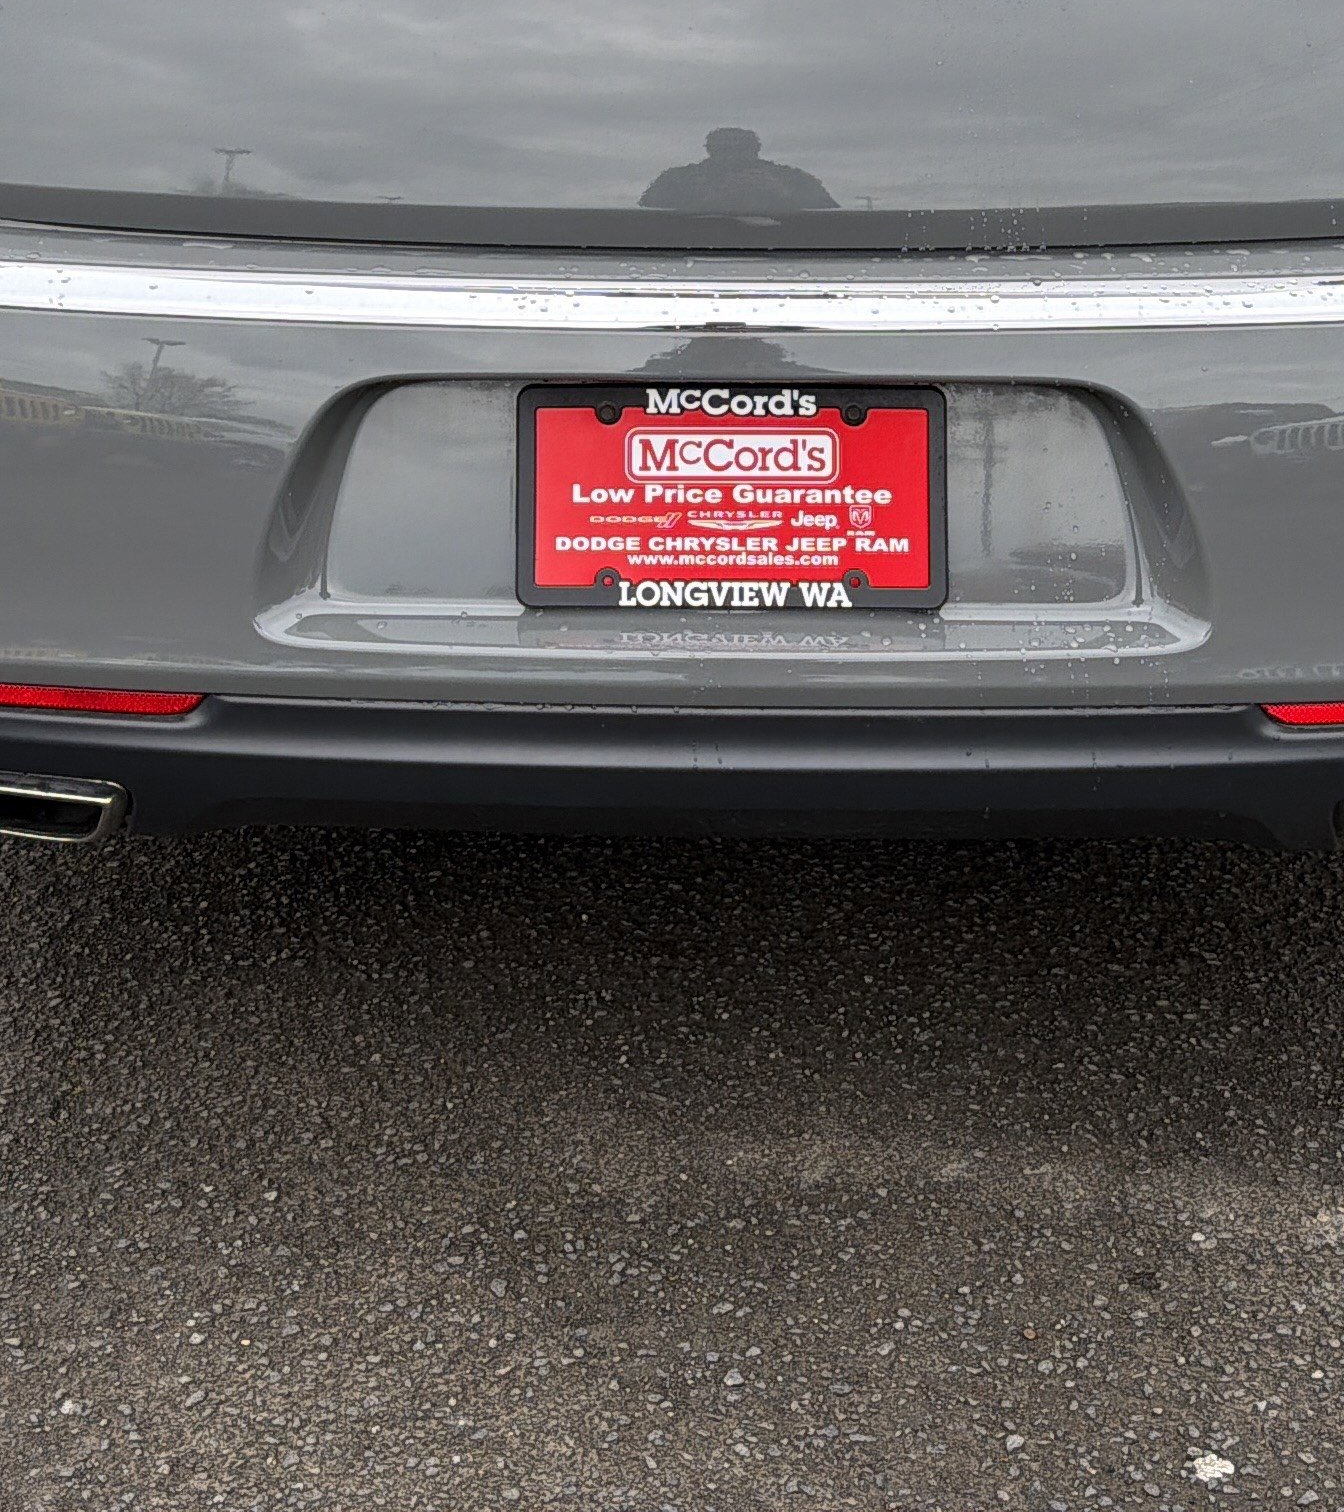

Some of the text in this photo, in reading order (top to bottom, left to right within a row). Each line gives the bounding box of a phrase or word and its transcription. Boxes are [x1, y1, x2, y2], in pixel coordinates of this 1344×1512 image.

[645, 388, 817, 417] McCord's
[638, 438, 826, 472] McCord's
[572, 484, 893, 504] Low Price Guarantee
[686, 510, 783, 519] CHRYSLER
[790, 510, 839, 531] Jeep
[556, 536, 909, 553] DODGE CHRYSLER JEEP RAM
[627, 552, 839, 567] www.mccordsales.com
[618, 581, 853, 608] LONGVIEW WA
